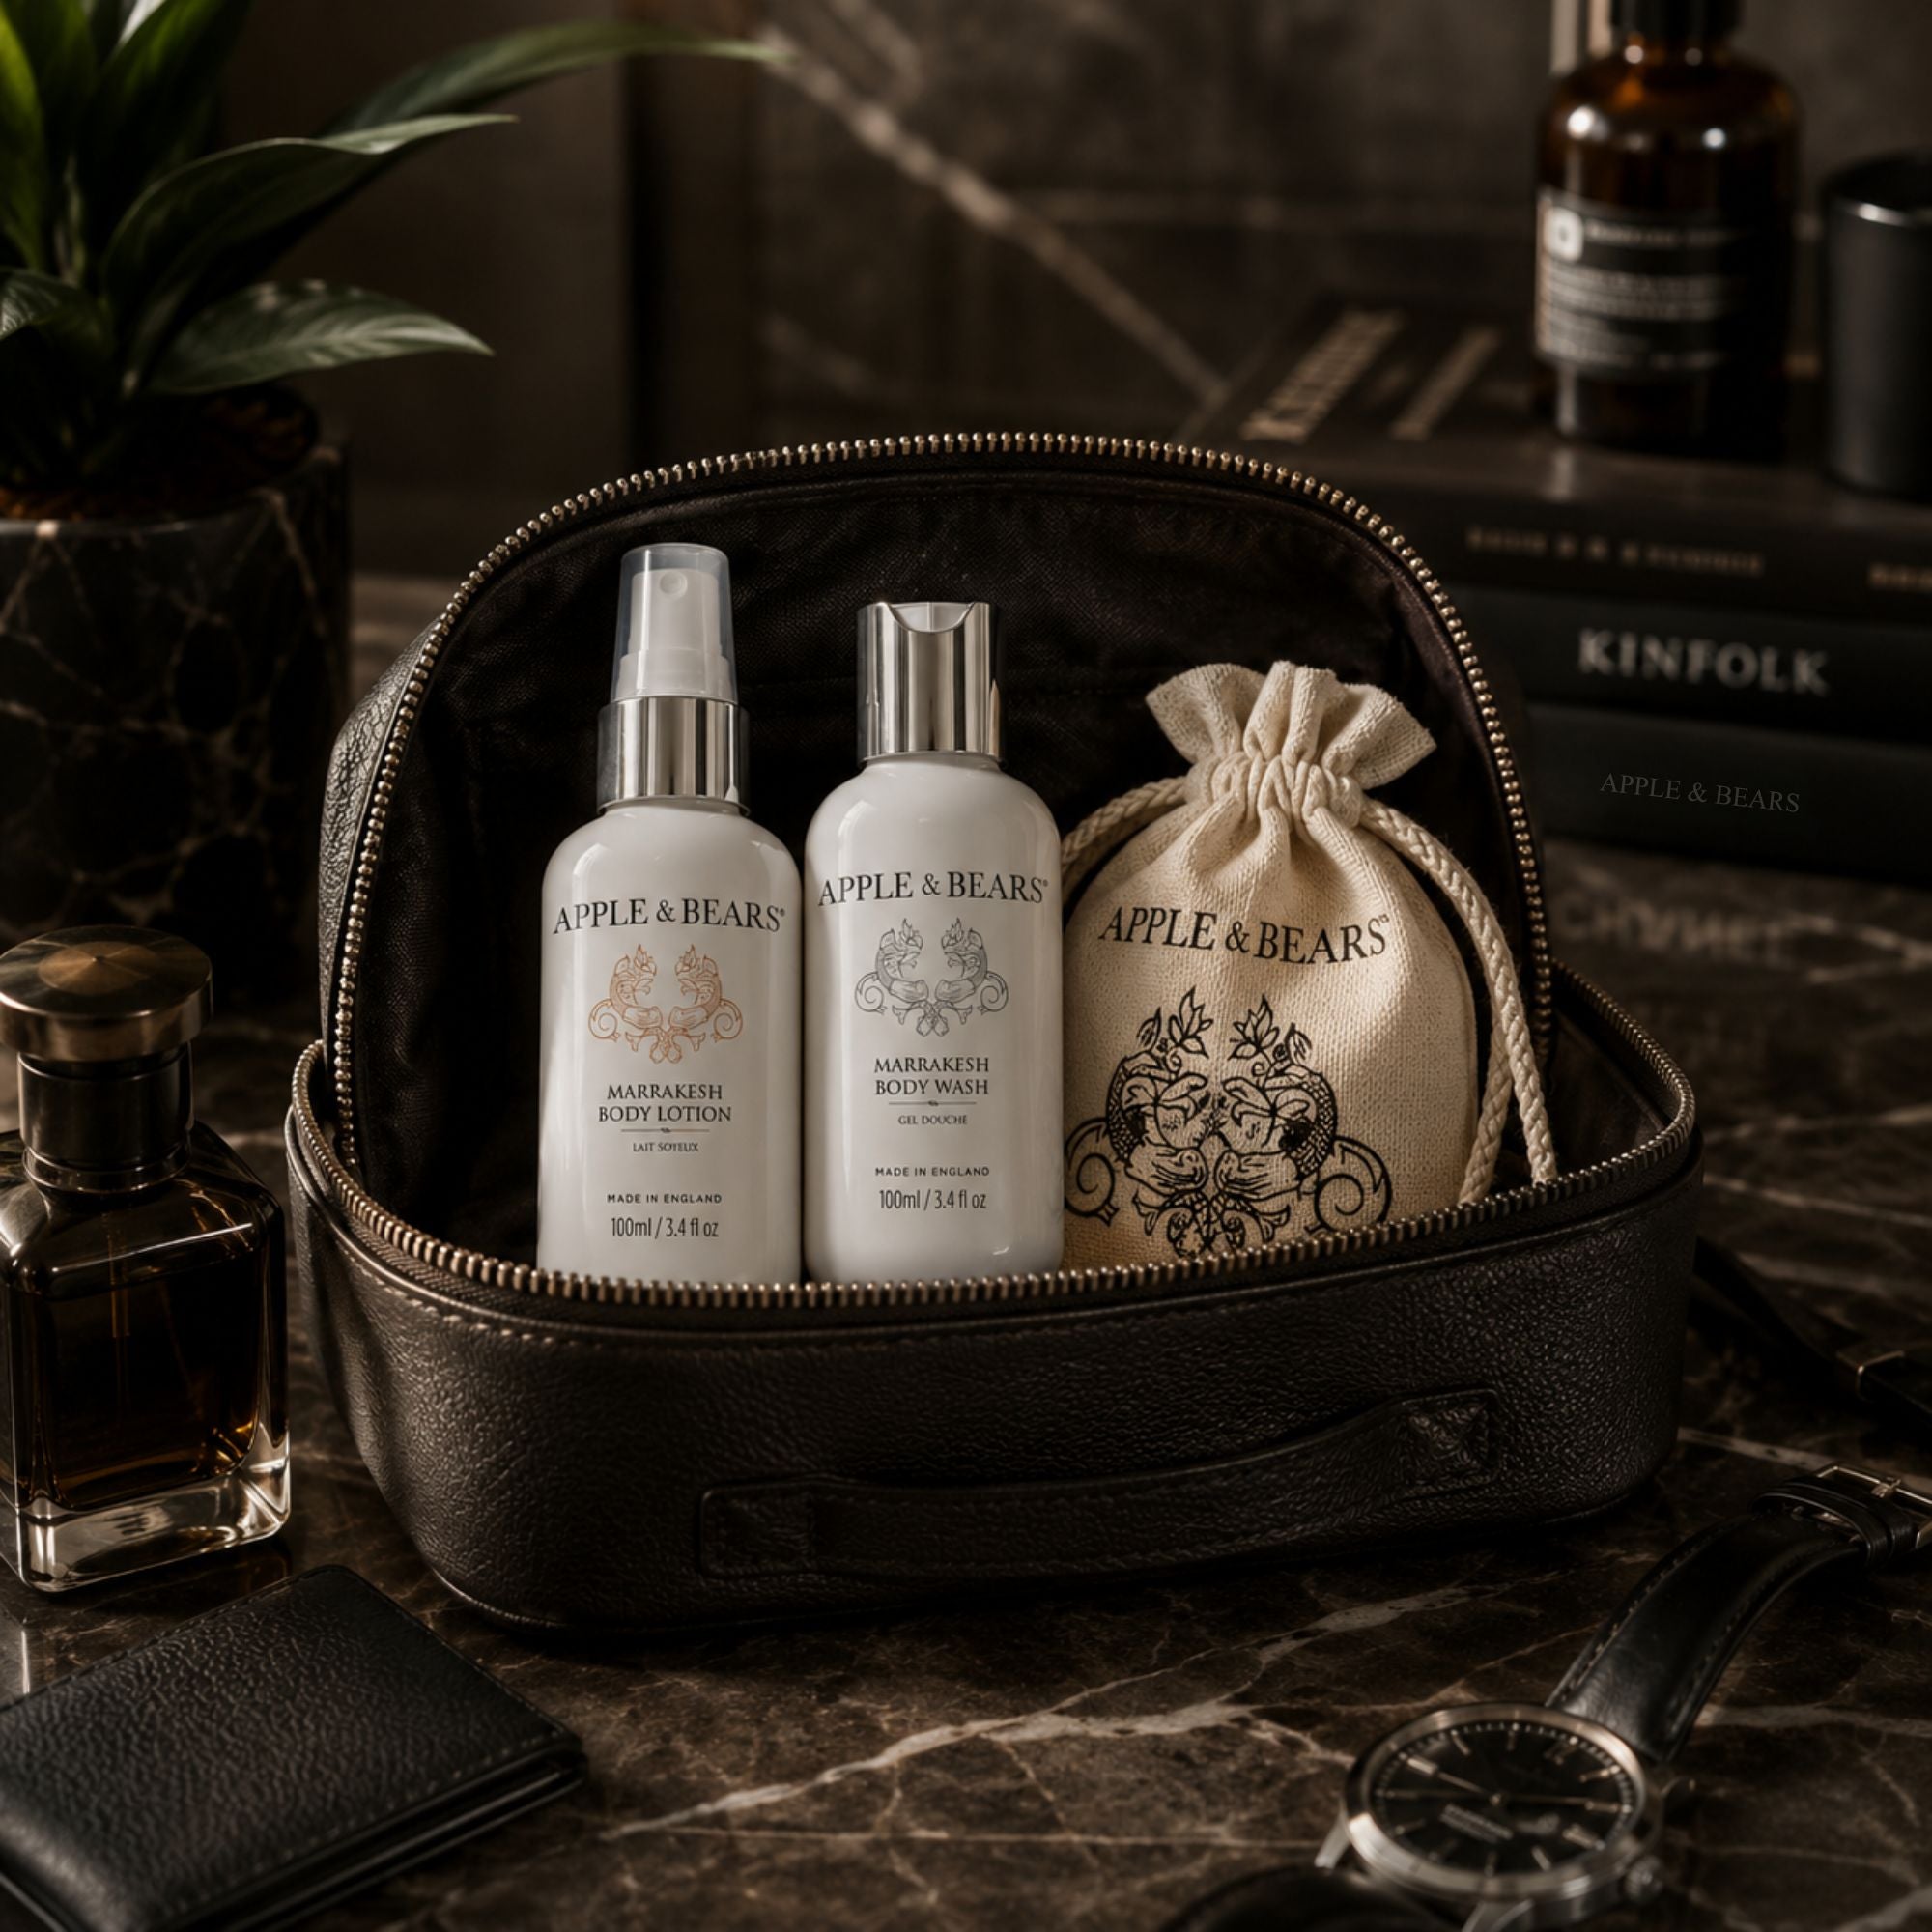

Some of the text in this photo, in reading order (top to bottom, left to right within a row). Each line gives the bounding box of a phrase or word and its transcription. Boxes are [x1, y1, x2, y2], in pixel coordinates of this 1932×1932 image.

[1577, 628, 1831, 696] KINFOLK
[1600, 773, 1801, 813] APPLE & BEARS
[818, 871, 914, 907] APPLE
[922, 872, 942, 896] &
[553, 898, 649, 934] APPLE
[656, 899, 676, 923] &
[1098, 906, 1218, 951] APPLE
[1225, 921, 1250, 953] &
[874, 1057, 989, 1073] MARRAKESH
[607, 1084, 723, 1100] MARRAKESH
[875, 1079, 989, 1095] BODY WASH
[598, 1106, 732, 1122] BODY LOTION
[898, 1115, 968, 1125] GEL DOUCHE
[633, 1142, 655, 1152] LAIT
[875, 1167, 990, 1177] MADE IN ENGLAND
[607, 1194, 723, 1204] MADE IN ENGLAND
[879, 1189, 921, 1209] 100ml
[934, 1190, 955, 1209] 3.4
[959, 1189, 968, 1209] fl
[971, 1193, 987, 1209] oz
[611, 1216, 652, 1237] 100ml
[666, 1217, 687, 1237] 3.4
[690, 1217, 699, 1237] fl
[702, 1221, 719, 1237] oz
